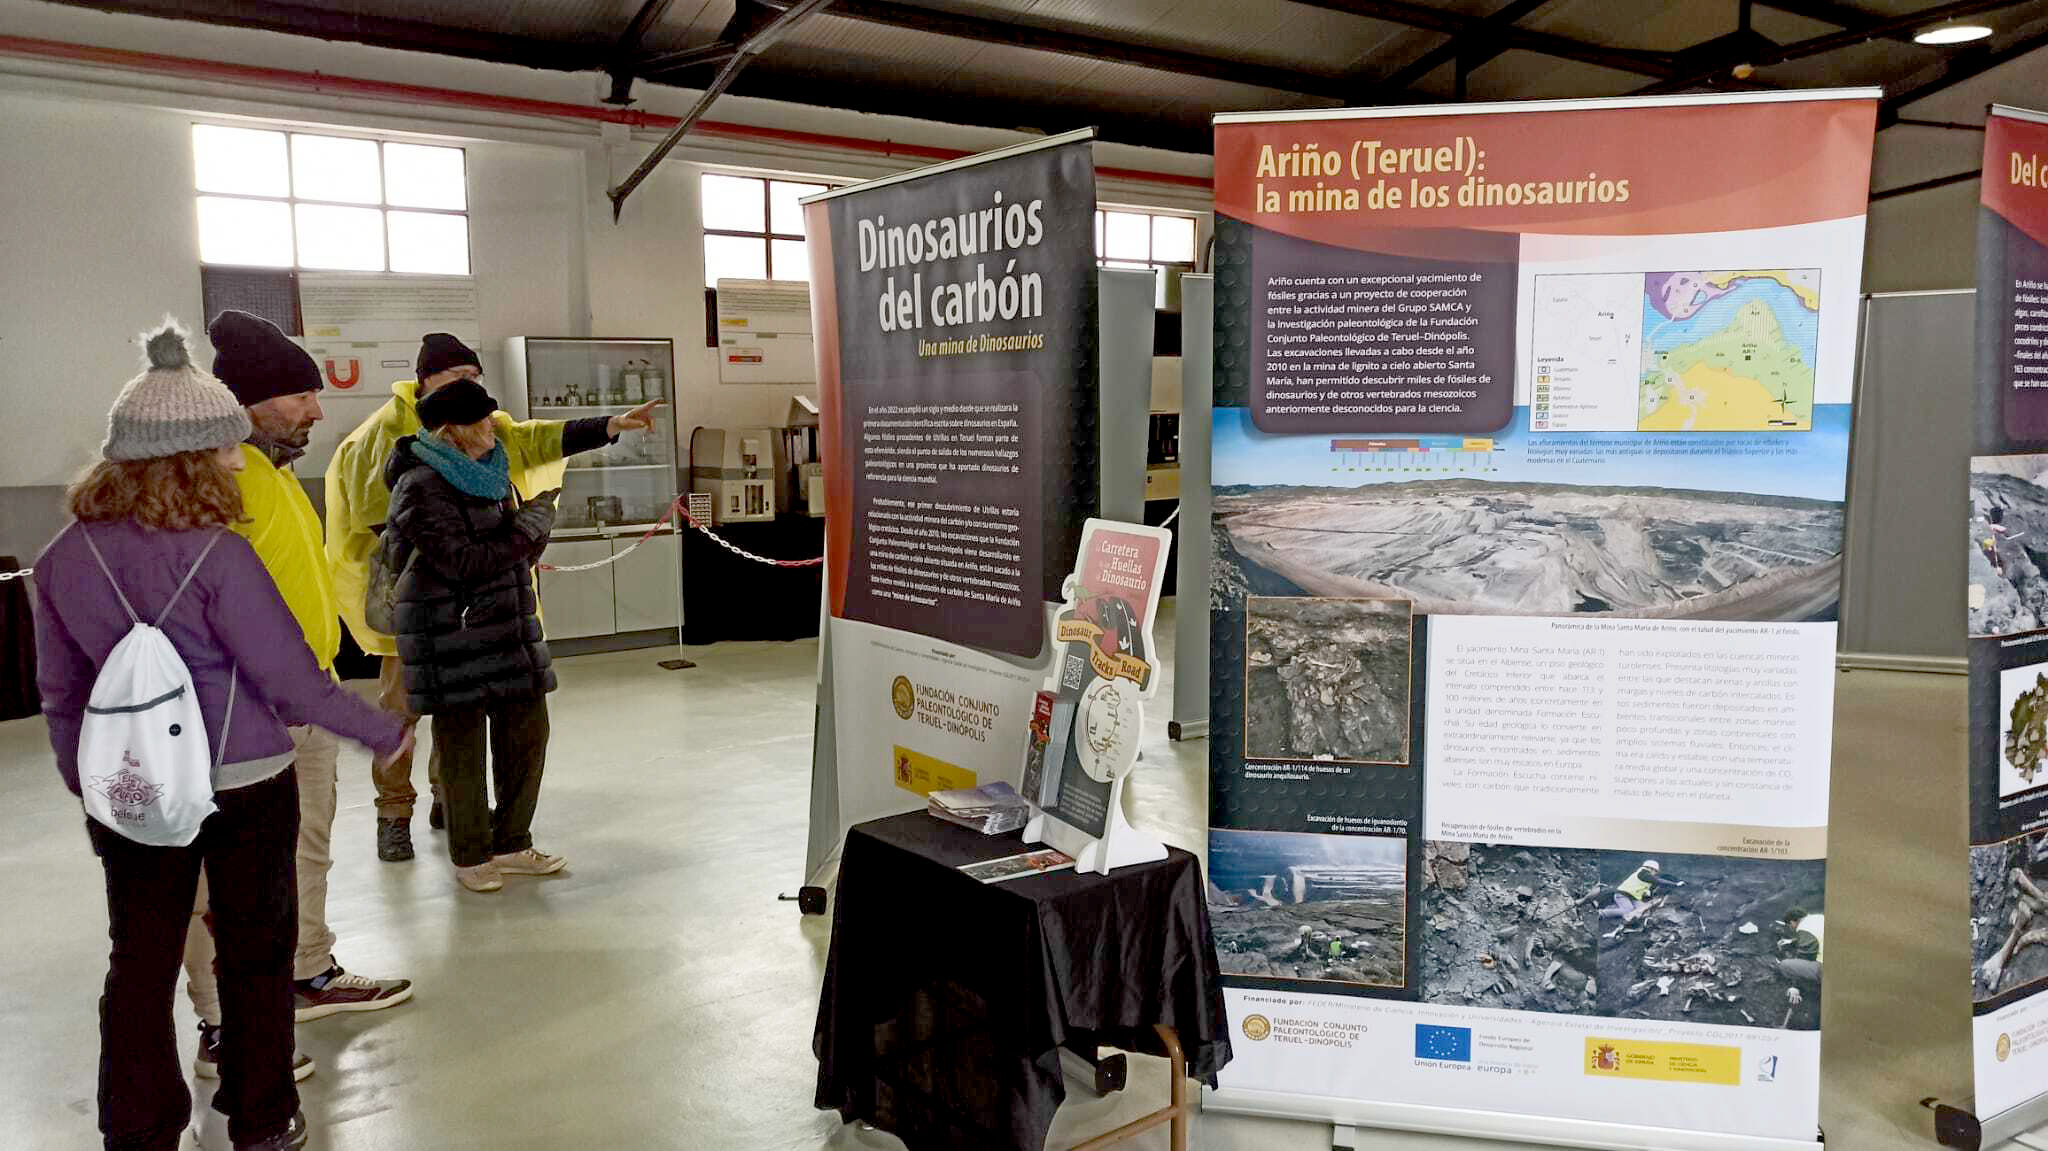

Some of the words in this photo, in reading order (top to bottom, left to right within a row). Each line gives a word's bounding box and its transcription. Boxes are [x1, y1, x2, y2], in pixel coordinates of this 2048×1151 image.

[1256, 143, 1342, 178] Ariño
[1350, 137, 1485, 180] (Teruel):
[2011, 152, 2036, 186] Del
[1257, 183, 1280, 213] la
[1289, 182, 1359, 212] mina
[1368, 180, 1402, 210] de
[1410, 178, 1450, 209] los
[1458, 172, 1629, 207] dinosaurios
[859, 190, 1042, 272] Dinosaurios
[1268, 276, 1292, 286] Ariño
[1295, 276, 1325, 285] cuenta
[1361, 274, 1414, 286] excepcional
[1416, 273, 1467, 285] yacimiento
[1470, 273, 1482, 282] de
[880, 273, 922, 332] del
[931, 259, 1042, 326] carbón
[1268, 291, 1296, 300] fósiles
[1298, 290, 1329, 302] gracias
[1354, 289, 1394, 301] proyecto
[1397, 289, 1408, 298] de
[1411, 288, 1466, 300] cooperación
[1268, 305, 1291, 314] entre
[1294, 305, 1301, 314] la
[1304, 304, 1344, 313] actividad
[1347, 304, 1379, 313] minera
[1382, 303, 1396, 312] del
[1398, 303, 1427, 314] Grupo
[1429, 302, 1463, 312] SAMCA
[1466, 305, 1471, 313] y
[1268, 320, 1275, 328] la
[1278, 319, 1335, 330] investigación
[1338, 318, 1403, 330] paleontológica
[1406, 317, 1417, 326] de
[1420, 317, 1427, 326] la
[1430, 317, 1478, 326] Fundación
[919, 339, 937, 356] Una
[939, 338, 964, 355] mina
[966, 336, 977, 352] de
[980, 329, 1044, 351] Dinosaurios
[1268, 333, 1307, 345] Conjunto
[1310, 333, 1374, 344] Paleontológico
[1377, 333, 1389, 341] de
[1268, 348, 1281, 356] Las
[1284, 347, 1342, 356] excavaciones
[1345, 347, 1381, 356] llevadas
[1392, 346, 1413, 355] cabo
[1416, 346, 1443, 355] desde
[1446, 346, 1454, 354] el
[1457, 345, 1474, 354] año
[1267, 362, 1287, 371] 2010
[1304, 362, 1311, 370] la
[1314, 361, 1335, 370] mina
[1338, 361, 1349, 370] de
[1352, 361, 1379, 372] lignito
[1390, 360, 1410, 369] cielo
[1413, 360, 1446, 369] abierto
[1448, 360, 1474, 369] Santa
[1267, 376, 1294, 387] María,
[1296, 376, 1313, 384] han
[1316, 375, 1359, 386] permitido
[1362, 375, 1404, 384] descubrir
[1407, 375, 1431, 383] miles
[1434, 374, 1445, 383] de
[1448, 374, 1476, 383] fósiles
[1479, 374, 1490, 383] de
[1266, 390, 1317, 399] dinosaurios
[1320, 392, 1325, 401] y
[1328, 390, 1338, 398] de
[1341, 389, 1364, 398] otros
[1367, 389, 1421, 398] vertebrados
[1424, 389, 1477, 398] mesozoicos
[1266, 404, 1330, 413] anteriormente
[1333, 404, 1392, 413] desconocidos
[1395, 406, 1416, 415] para
[1418, 404, 1426, 412] la
[1429, 403, 1462, 412] ciencia.
[1101, 541, 1138, 558] Carretera
[1112, 558, 1141, 573] Huellas
[1102, 570, 1146, 590] Dinosaurio
[1061, 626, 1091, 639] Dinosaur
[1092, 652, 1113, 676] Tracks
[1121, 661, 1141, 678] Road
[916, 684, 954, 704] FUNDACIÓN
[959, 695, 999, 716] CONJUNTO
[917, 698, 979, 725] PALEONTOLÓGICO
[983, 716, 992, 729] DE
[918, 712, 985, 742] TERUEL-DINÓPOLIS
[1244, 995, 1286, 1004] Financiado
[1274, 1018, 1318, 1027] FUNDACIÓN
[1324, 1022, 1368, 1032] CONJUNTO
[1274, 1027, 1345, 1039] PALEONTOLÓGICO
[1274, 1035, 1352, 1048] TERUEL-DINÓPOLIS
[1440, 1061, 1471, 1070] Europea
[1477, 1064, 1512, 1074] europa
